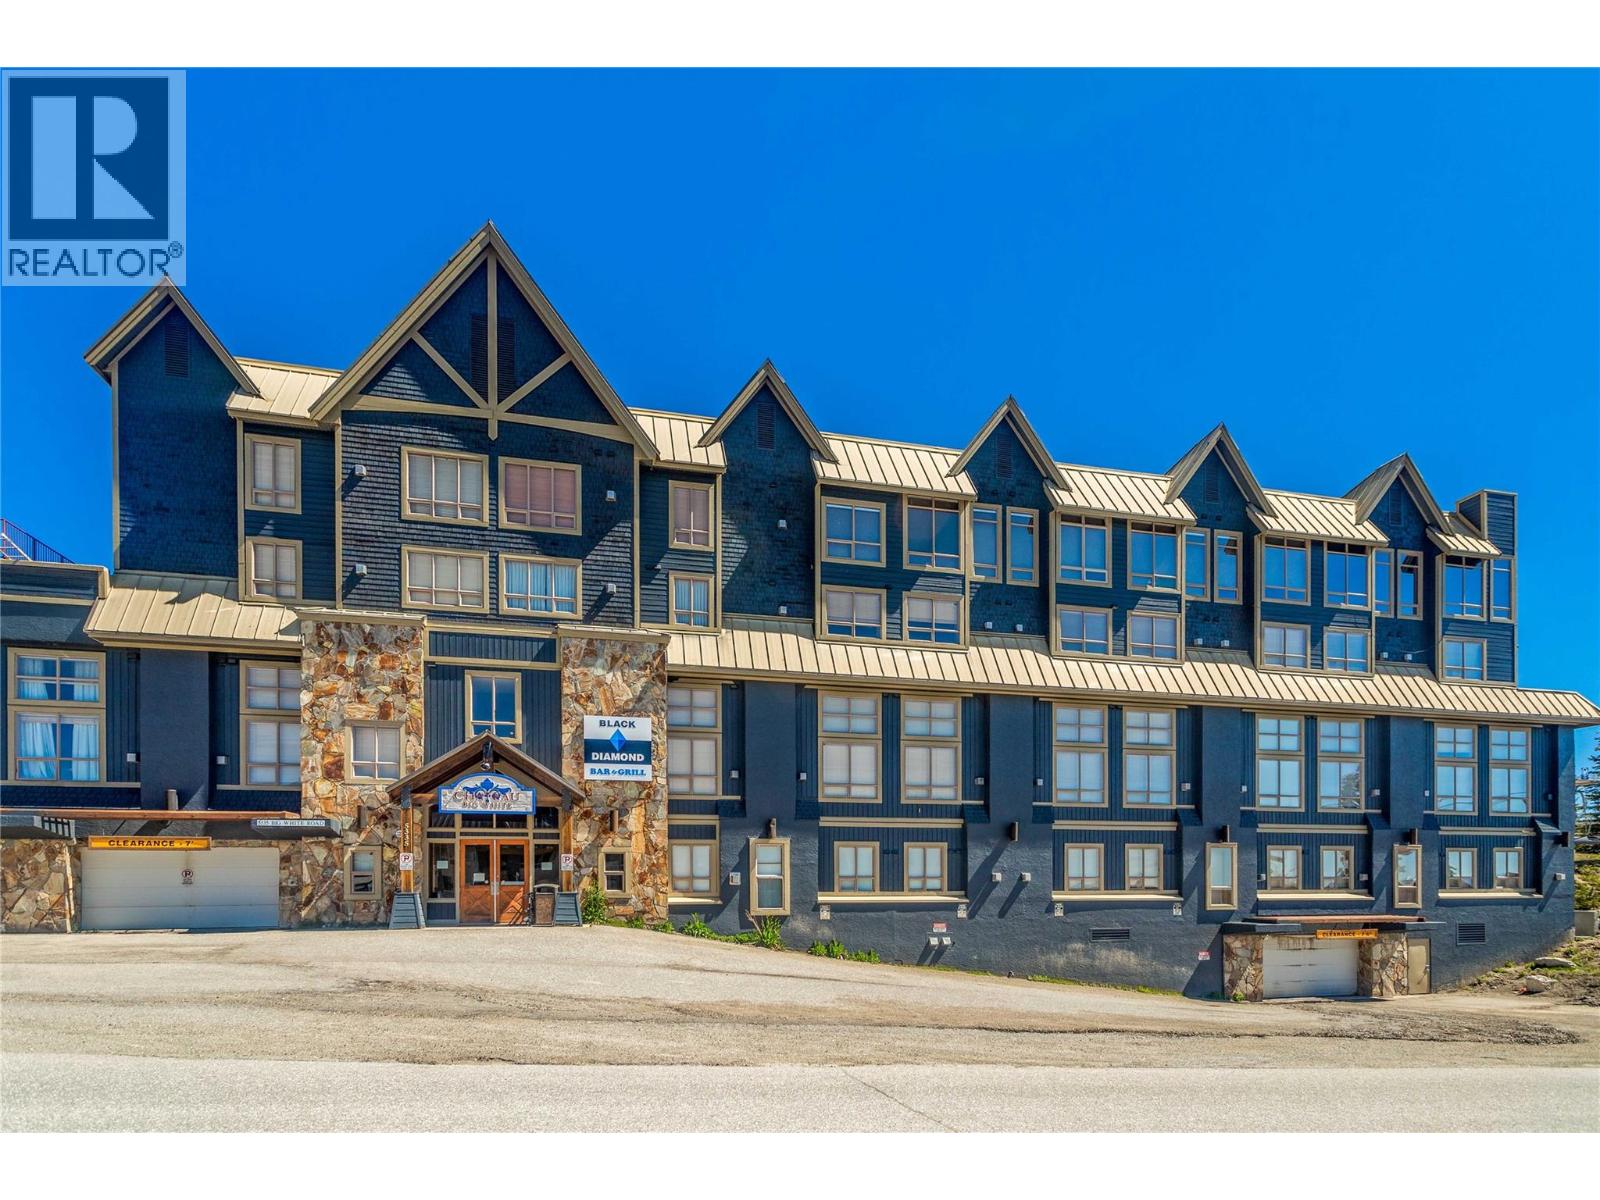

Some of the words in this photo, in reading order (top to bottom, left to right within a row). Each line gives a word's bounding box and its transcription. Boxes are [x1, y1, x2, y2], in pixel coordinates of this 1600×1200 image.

[599, 719, 636, 728] BLACK
[591, 752, 645, 762] DIAMOND
[618, 768, 647, 776] GRILL
[108, 839, 175, 847] CLEARANCE
